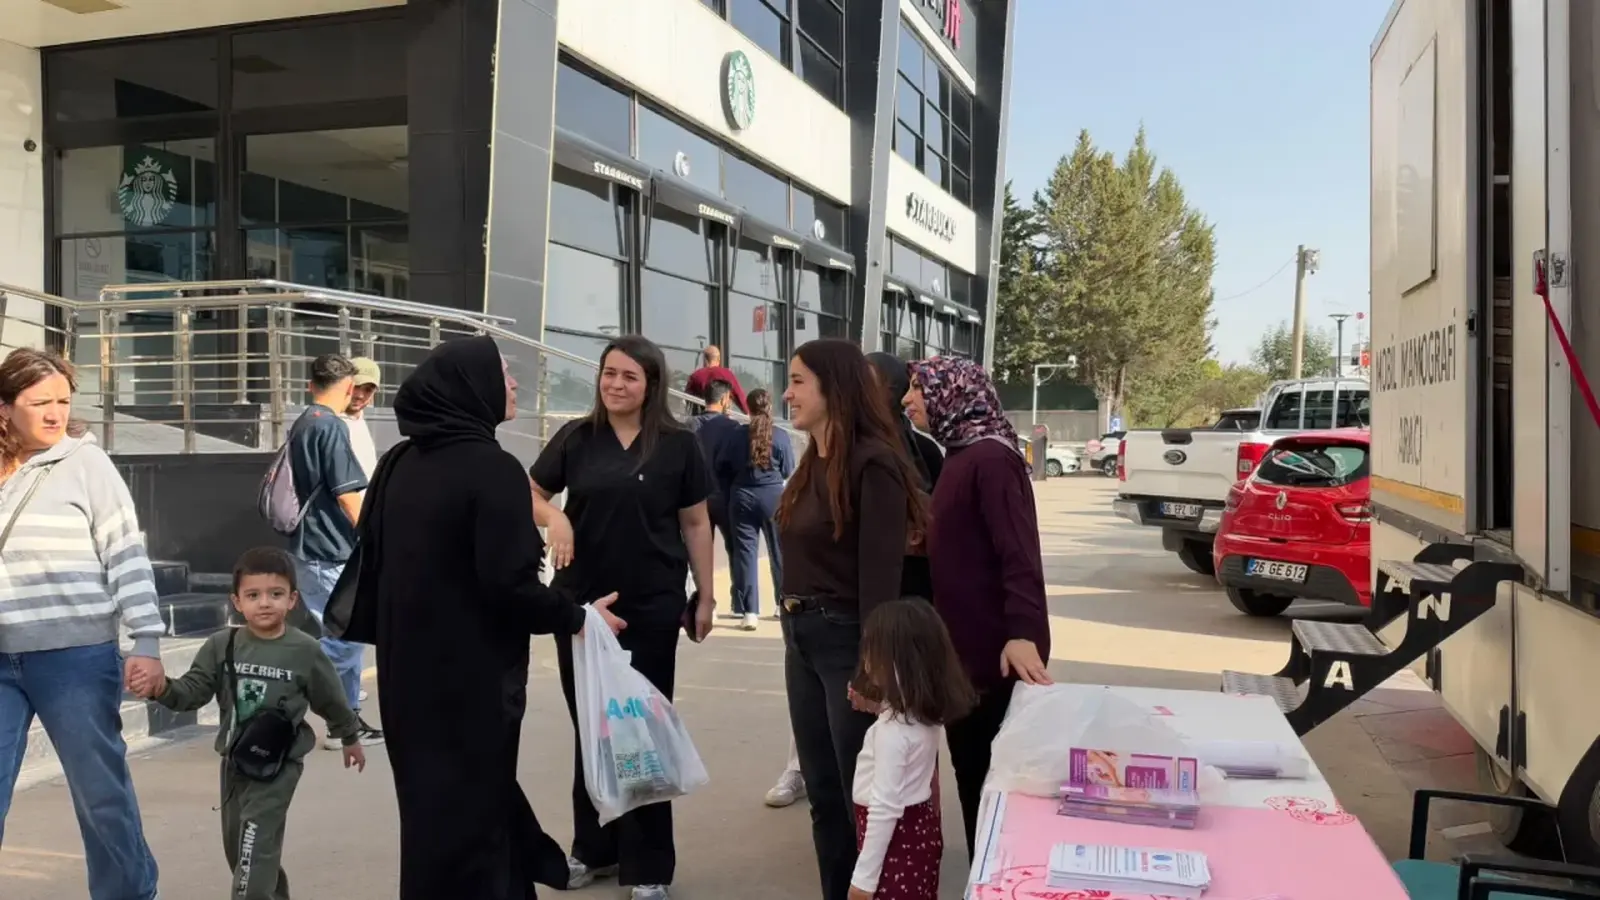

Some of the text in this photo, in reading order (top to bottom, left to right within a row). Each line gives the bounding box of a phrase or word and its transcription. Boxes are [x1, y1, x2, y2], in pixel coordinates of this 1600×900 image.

[593, 161, 643, 189] STARBUCKS
[906, 191, 957, 243] STARBUCKS
[1400, 307, 1456, 388] MAMOGRAFİ
[1268, 513, 1293, 521] CLIO
[1252, 560, 1305, 579] 26 GE 612
